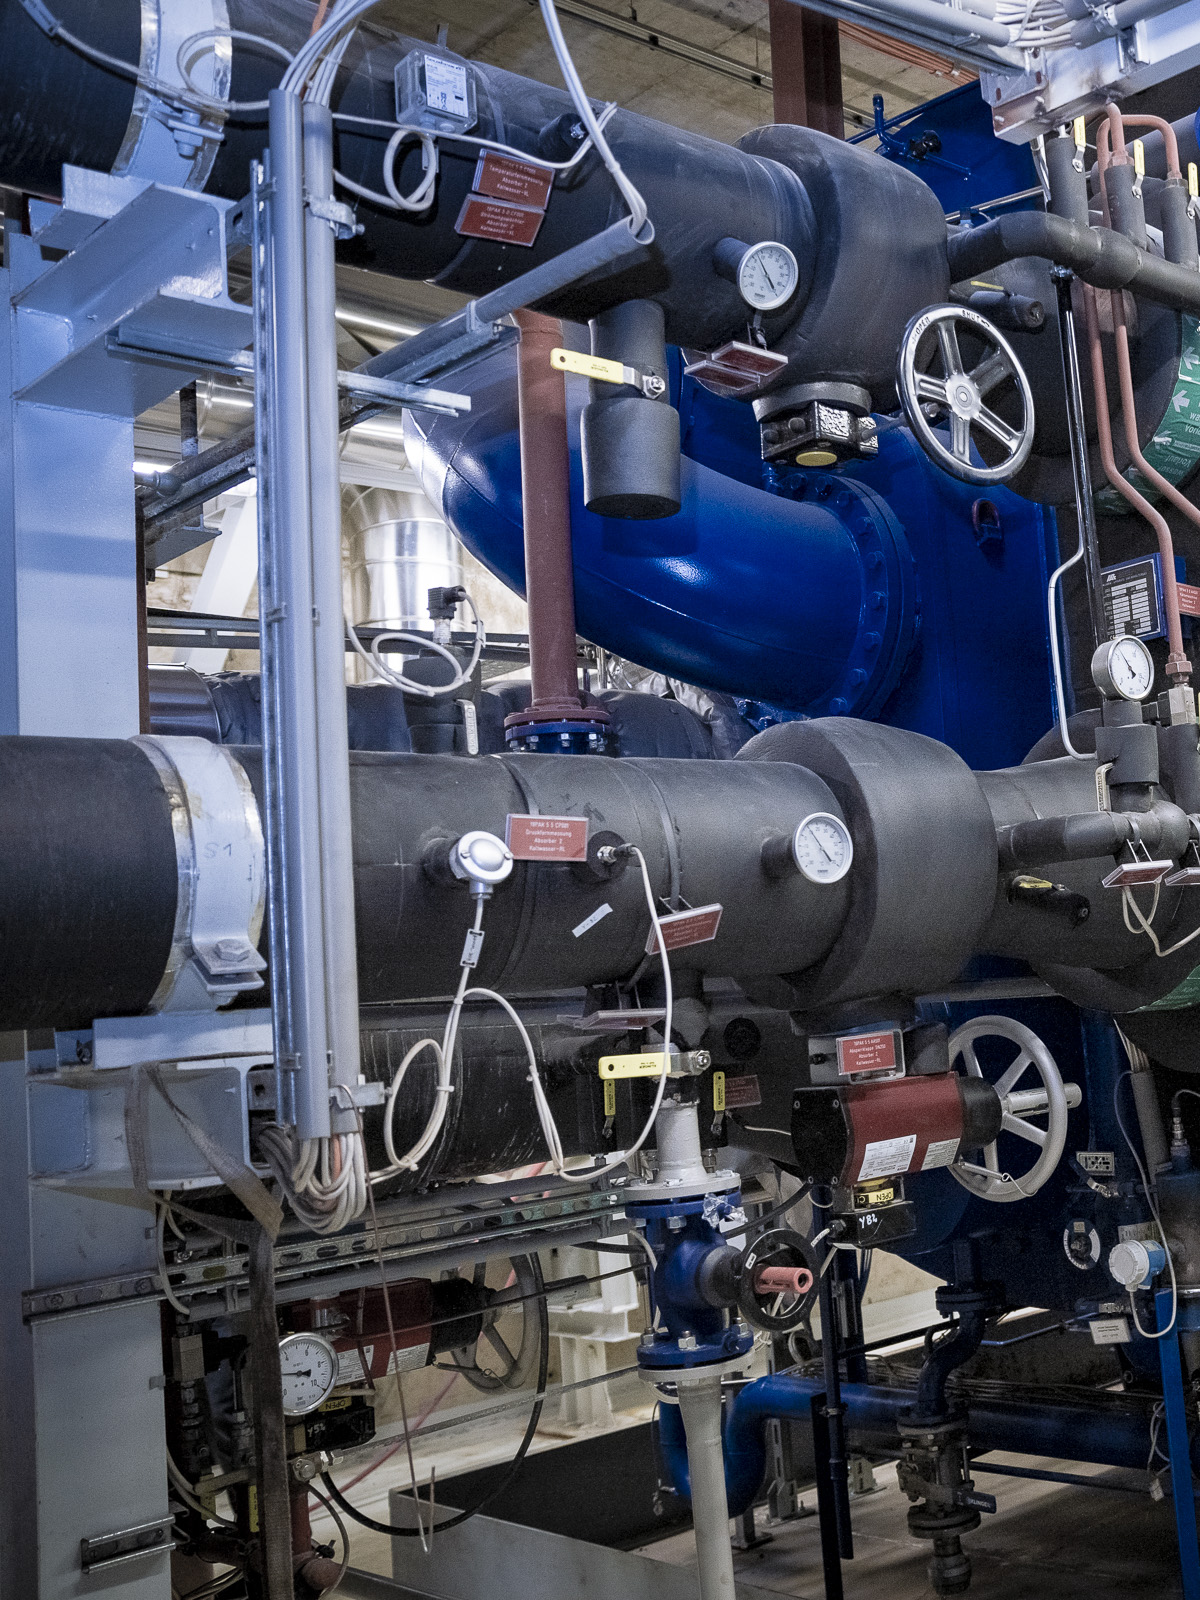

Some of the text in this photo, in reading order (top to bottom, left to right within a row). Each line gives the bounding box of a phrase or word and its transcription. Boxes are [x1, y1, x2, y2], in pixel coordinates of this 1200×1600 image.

[502, 177, 523, 186] Absorber
[486, 220, 509, 228] Absorber
[962, 310, 979, 321] SHUT
[526, 829, 572, 838] Druckfernmessung
[876, 1192, 892, 1201] OPEN
[326, 1400, 346, 1409] OPEN
